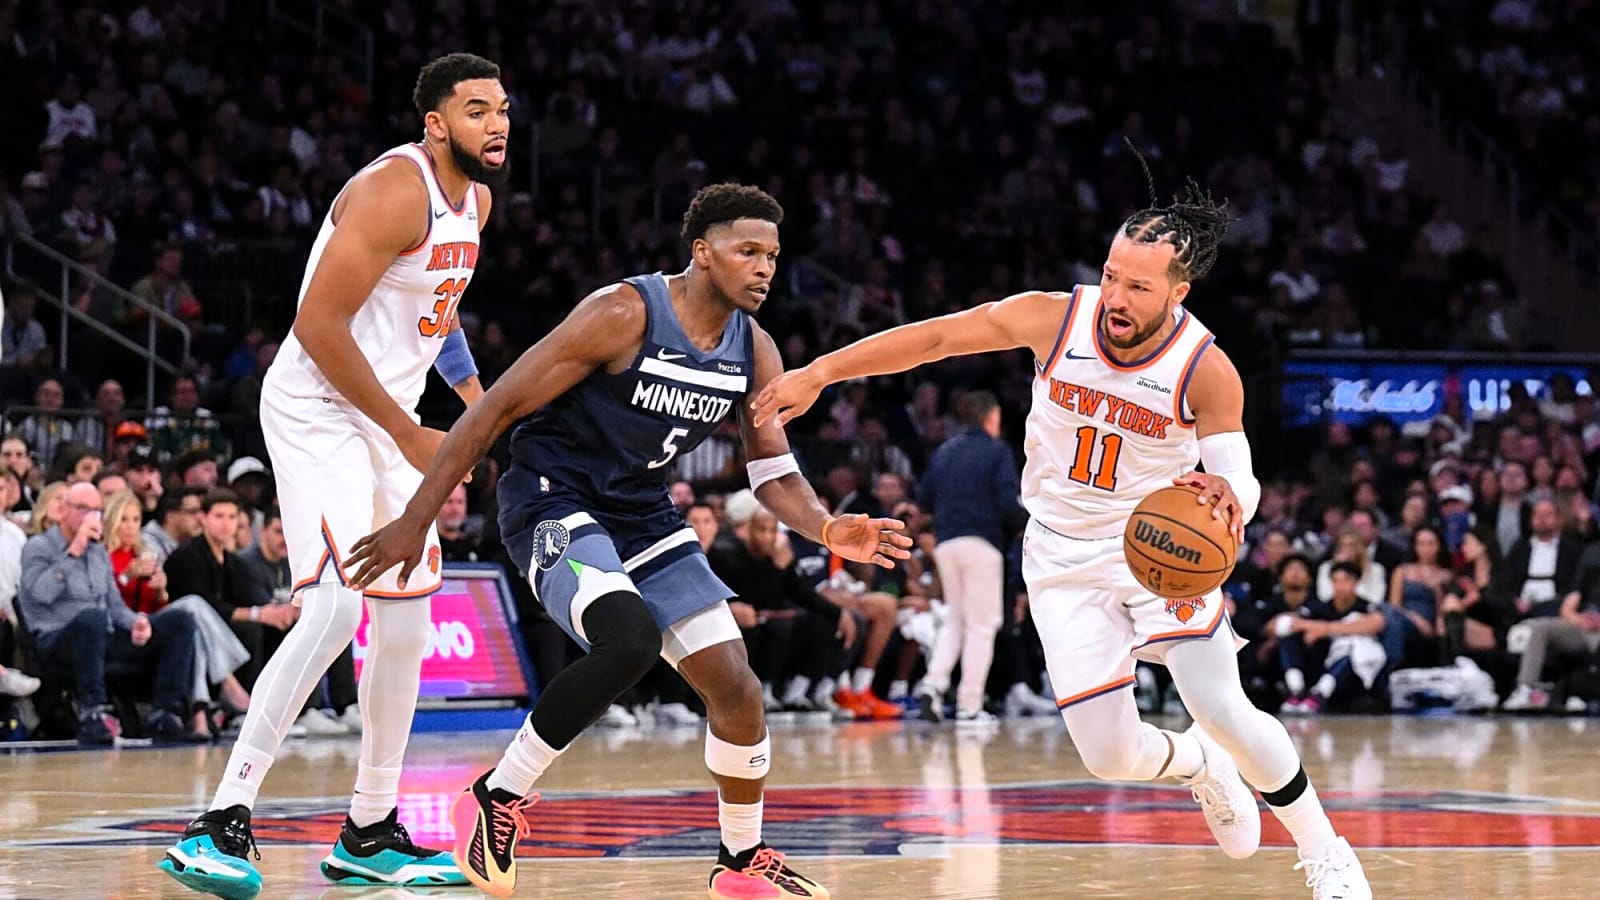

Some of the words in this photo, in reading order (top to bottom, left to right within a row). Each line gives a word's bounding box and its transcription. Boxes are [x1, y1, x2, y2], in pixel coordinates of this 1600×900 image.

[1049, 377, 1105, 417] NEW
[1104, 393, 1174, 440] YORK
[647, 427, 689, 470] 5
[1068, 426, 1123, 492] 11
[1134, 519, 1203, 565] Wilson
[749, 753, 766, 768] 5
